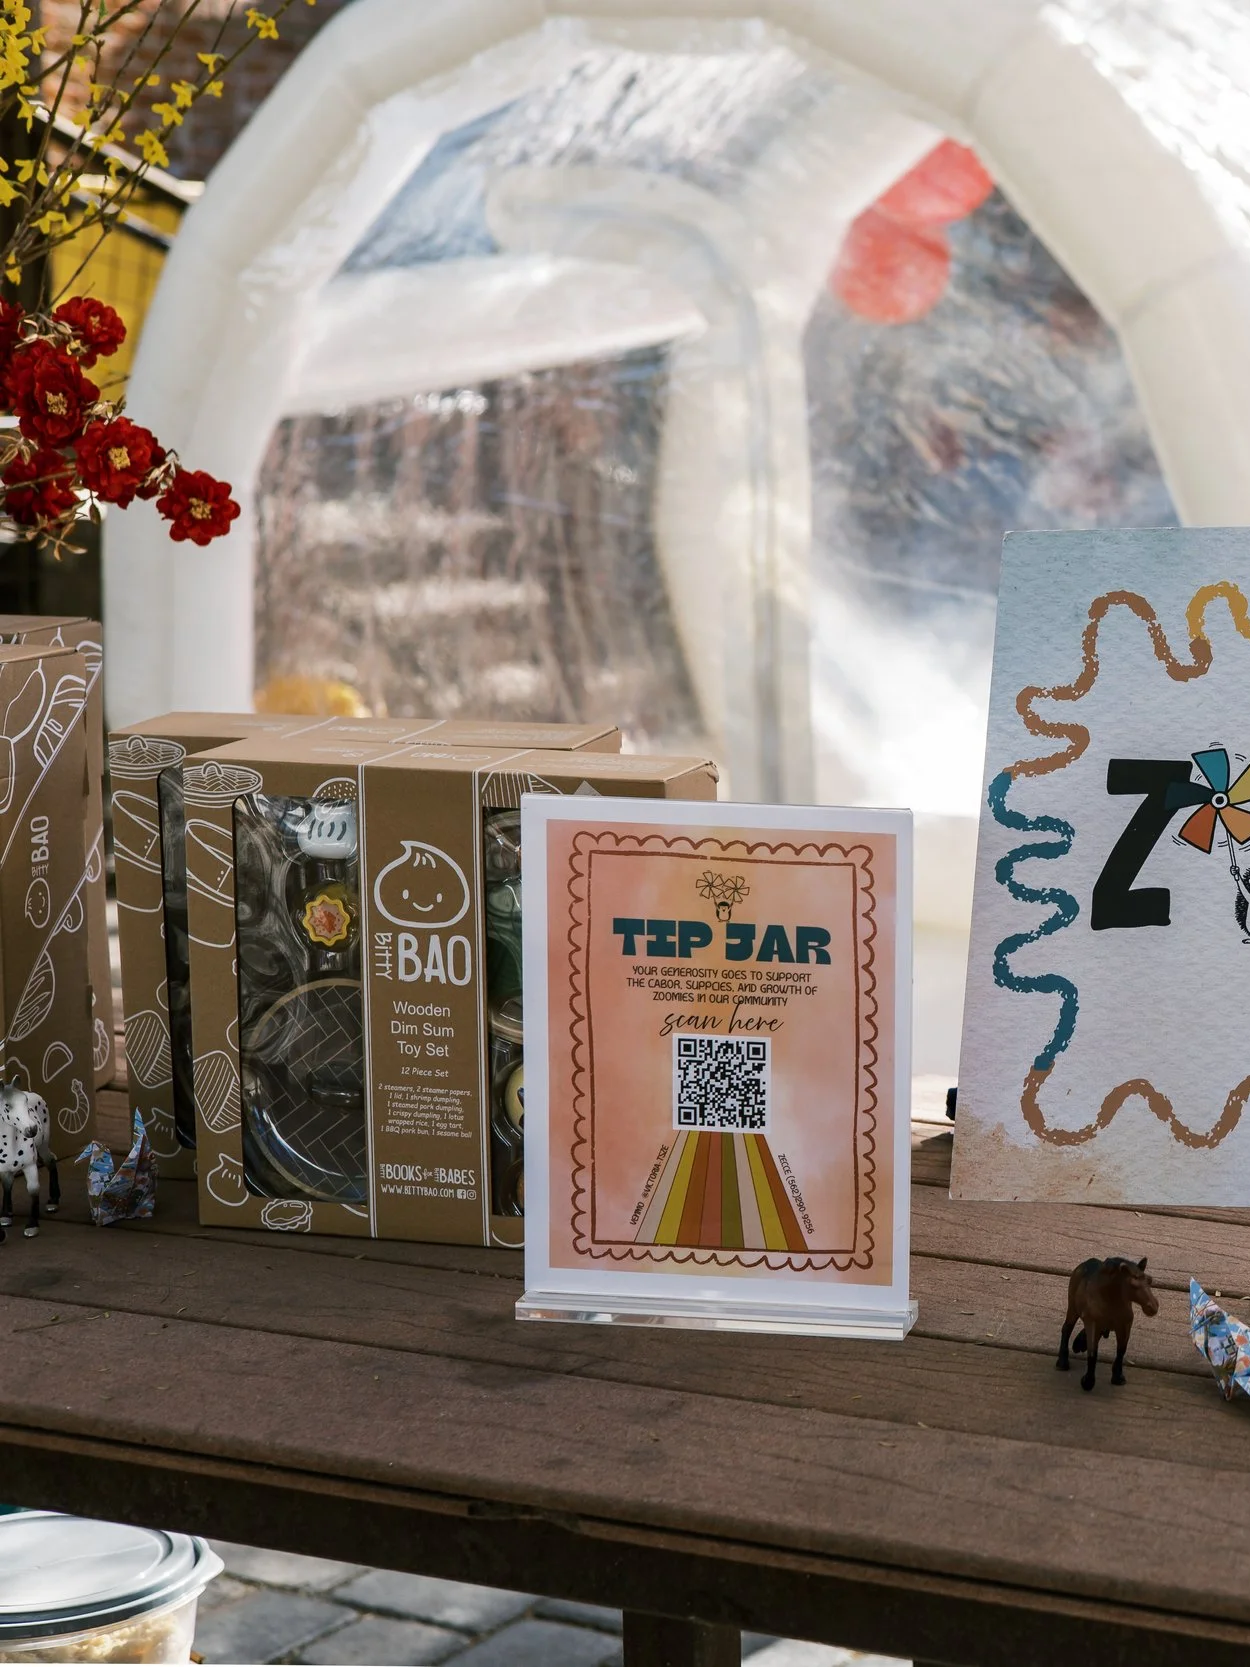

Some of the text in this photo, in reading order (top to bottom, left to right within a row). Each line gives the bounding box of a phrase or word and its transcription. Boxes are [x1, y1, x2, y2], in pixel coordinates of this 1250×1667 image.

[30, 815, 49, 863] BAO
[612, 917, 832, 965] TIP JAR
[397, 932, 472, 987] BAO
[632, 965, 812, 983] YOUR GENEROSITY GOES TO SUPPORT
[626, 977, 646, 988] THE
[737, 982, 757, 993] AND
[760, 983, 802, 995] GROWTH
[804, 985, 818, 996] OF
[652, 991, 788, 1007] ZOOMIES IN OUR COMMUNITY
[392, 1000, 451, 1018] Wooden
[659, 1001, 784, 1037] scan here
[390, 1020, 455, 1038] Dim Sum
[396, 1040, 449, 1058] Toy Set
[401, 1066, 449, 1078] 12 Piece Set
[410, 1093, 432, 1102] shrimp
[422, 1086, 449, 1094] steamer
[391, 1101, 419, 1109] steamed
[419, 1103, 434, 1111] pork
[392, 1109, 412, 1118] crispy
[448, 1113, 465, 1121] lotus
[385, 1125, 400, 1134] BBQ
[401, 1127, 416, 1135] pork
[436, 1130, 459, 1138] sesame
[460, 1130, 473, 1139] ball
[387, 1118, 415, 1127] wrapped
[435, 1122, 448, 1130] egg
[385, 1163, 423, 1182] BOOKS
[440, 1167, 476, 1186] BABES
[380, 1183, 455, 1198] WWW.BITTYBAO.COM
